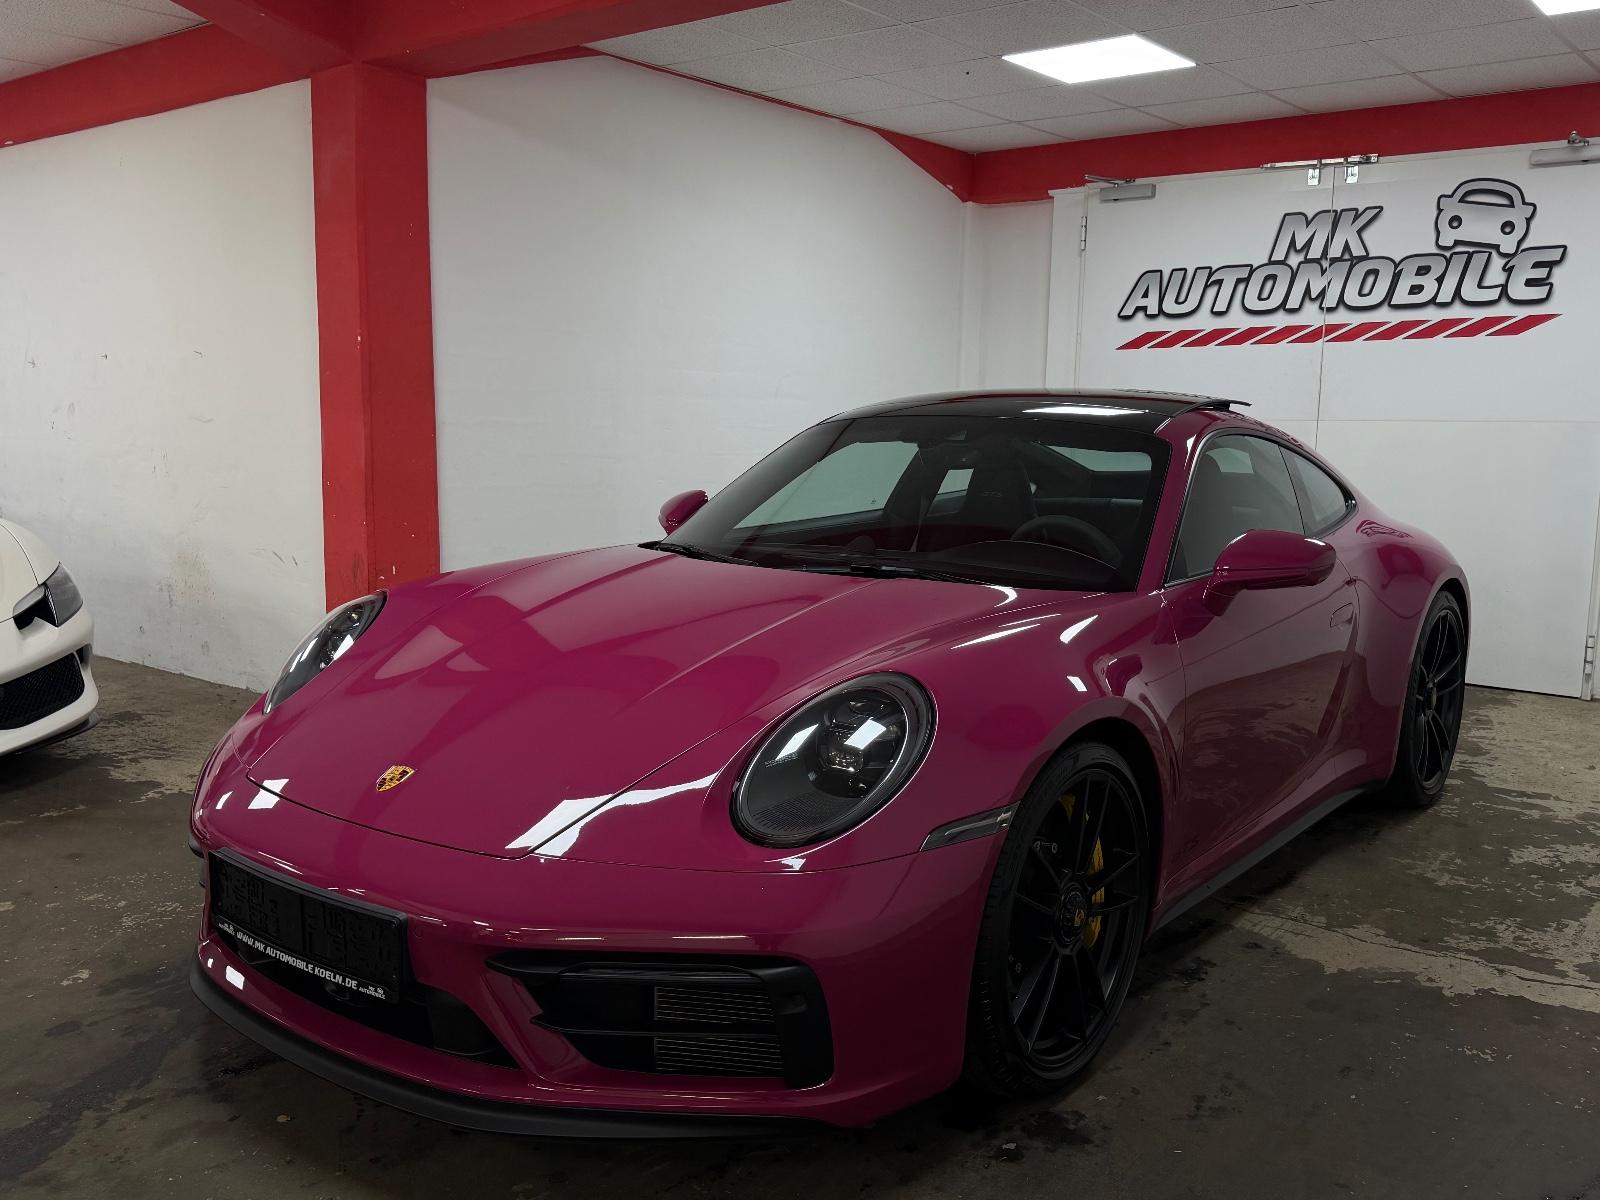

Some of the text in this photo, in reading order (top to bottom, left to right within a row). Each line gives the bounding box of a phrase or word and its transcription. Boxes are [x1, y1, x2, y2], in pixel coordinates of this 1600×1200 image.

[1268, 206, 1384, 262] MK
[1118, 245, 1567, 319] AUTOMOBILE
[236, 931, 358, 990] WWW.MK AUTOMOBILE KOELN.DE
